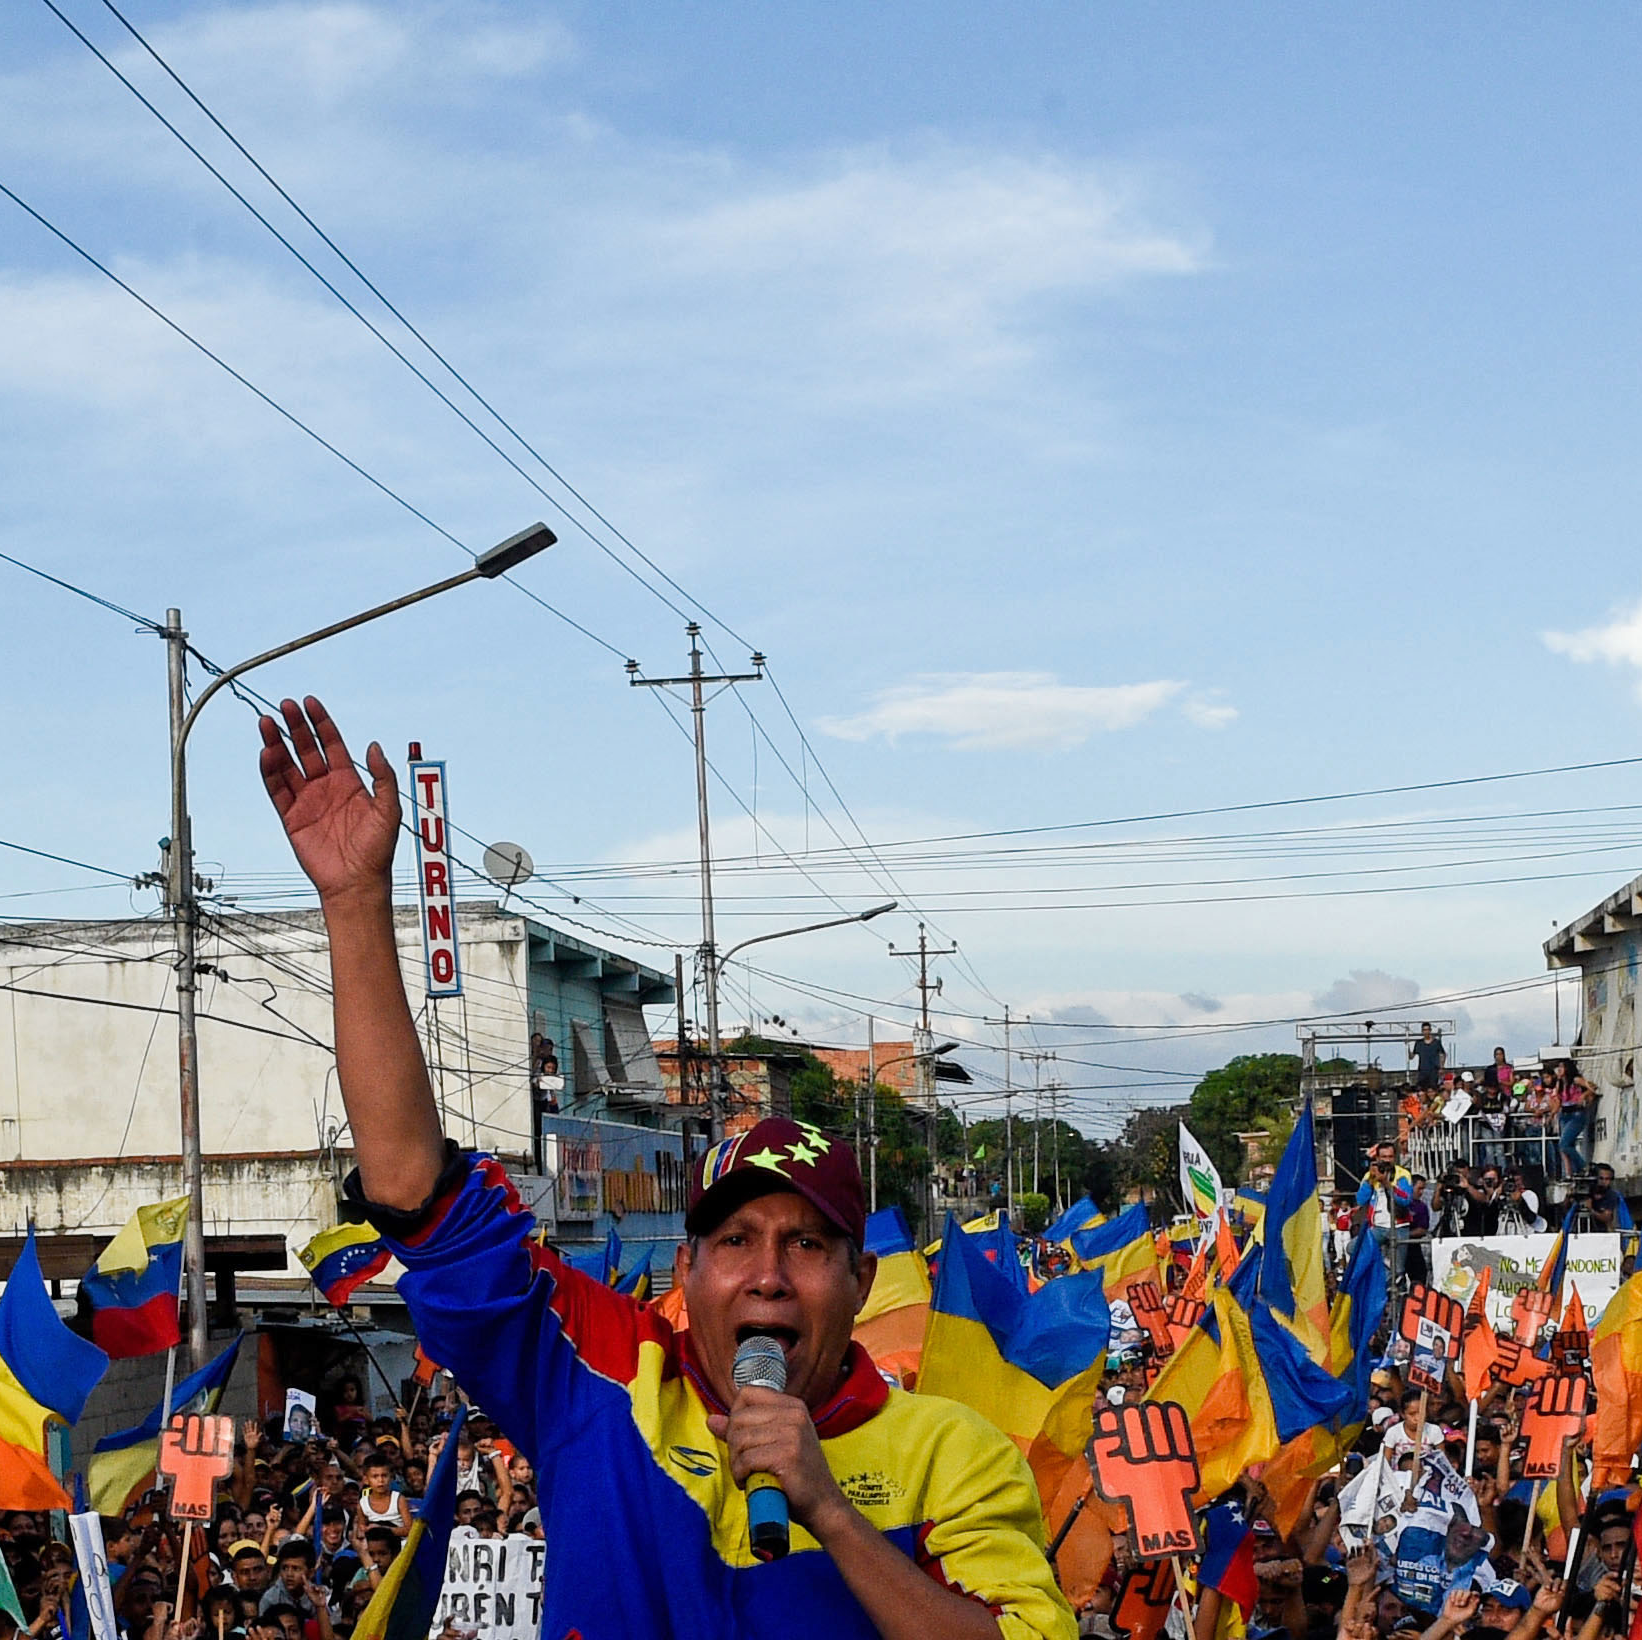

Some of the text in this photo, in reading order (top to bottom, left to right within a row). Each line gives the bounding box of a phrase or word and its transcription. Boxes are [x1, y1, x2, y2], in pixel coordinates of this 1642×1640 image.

[418, 774, 454, 983] TURNO
[1499, 1257, 1617, 1273] NO ME ANDONEN
[1527, 1463, 1557, 1475] MAS
[174, 1502, 208, 1516] MAS
[1141, 1529, 1191, 1552] MAS
